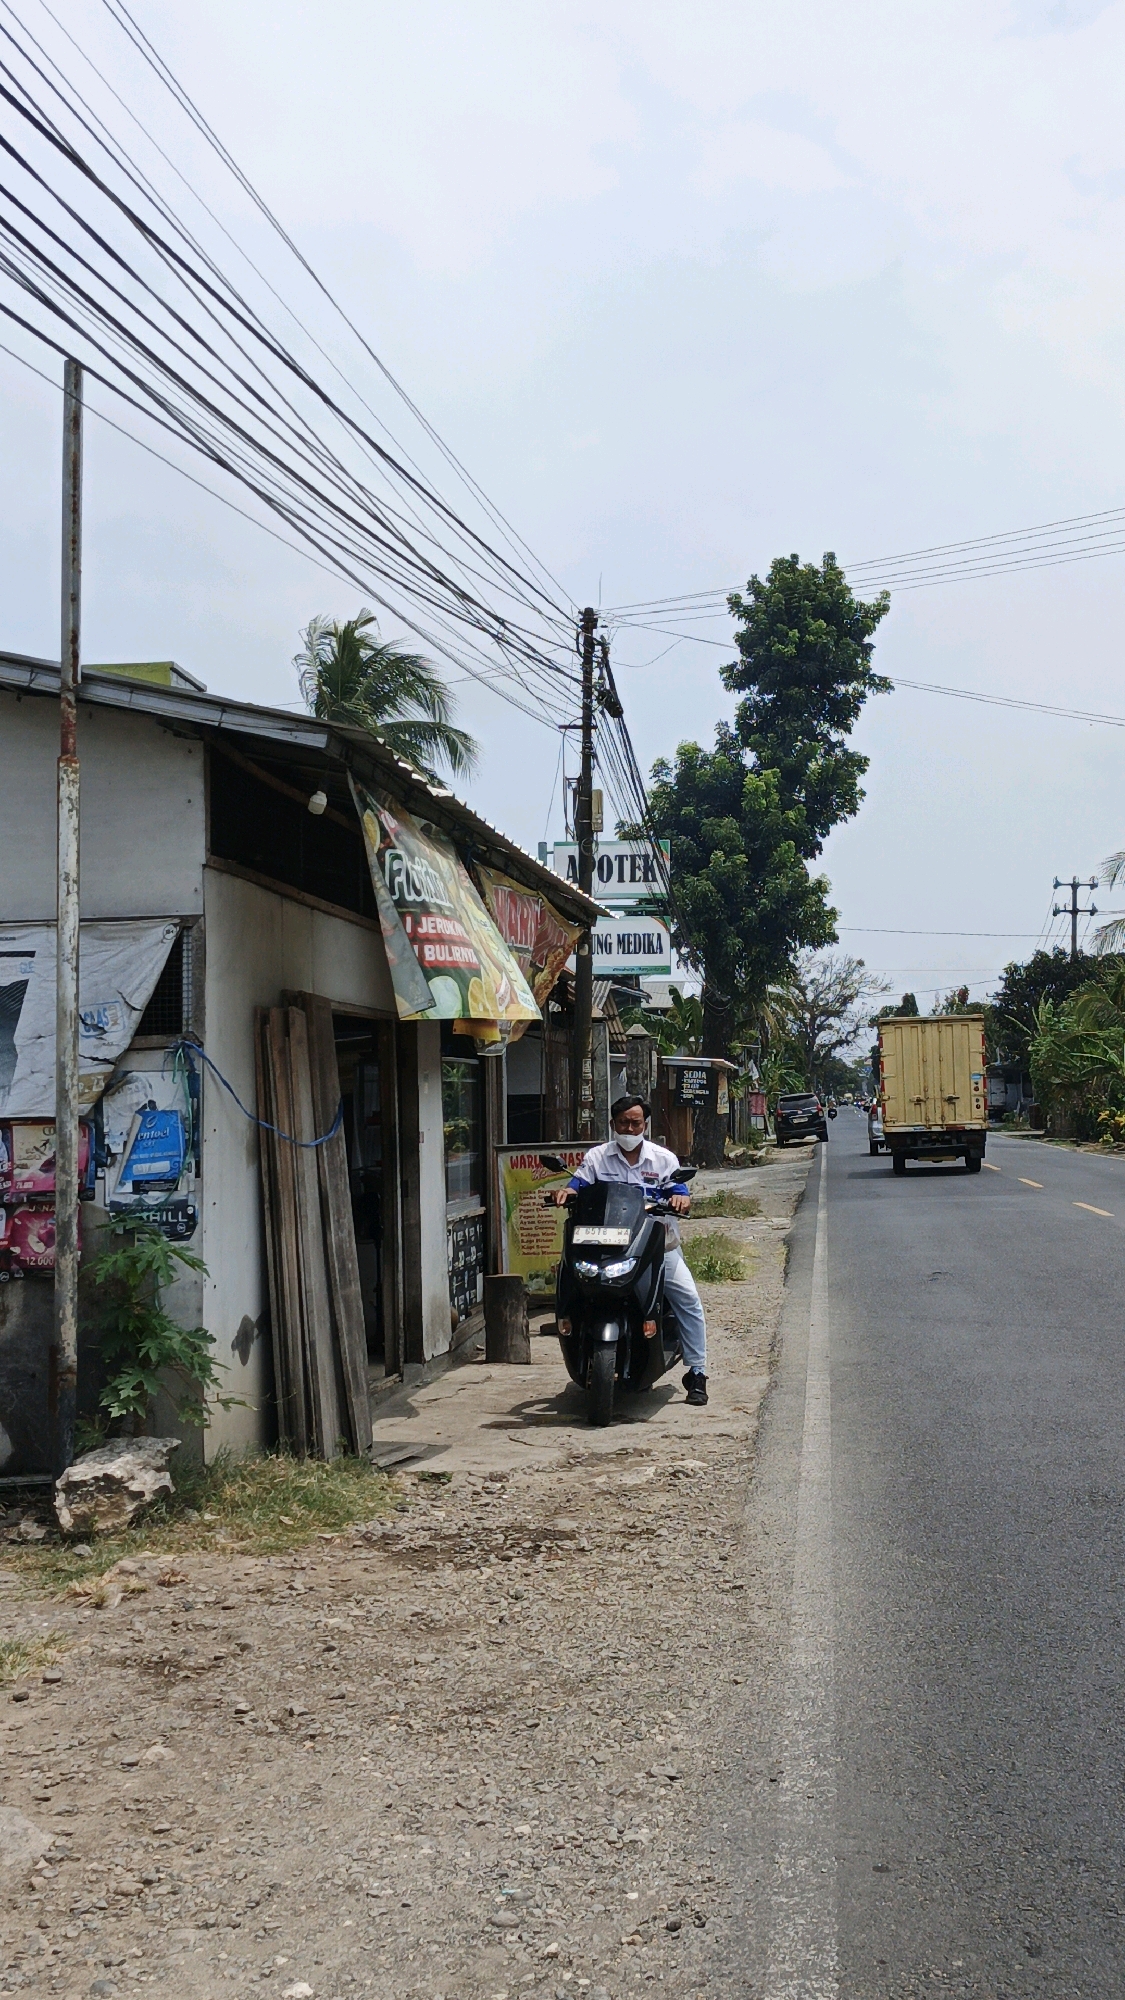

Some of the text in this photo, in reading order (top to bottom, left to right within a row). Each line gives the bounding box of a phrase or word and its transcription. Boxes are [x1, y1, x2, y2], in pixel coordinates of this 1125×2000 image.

[566, 854, 658, 884] AOTEK
[616, 933, 664, 956] MEDIKA
[137, 1127, 170, 1141] entoel
